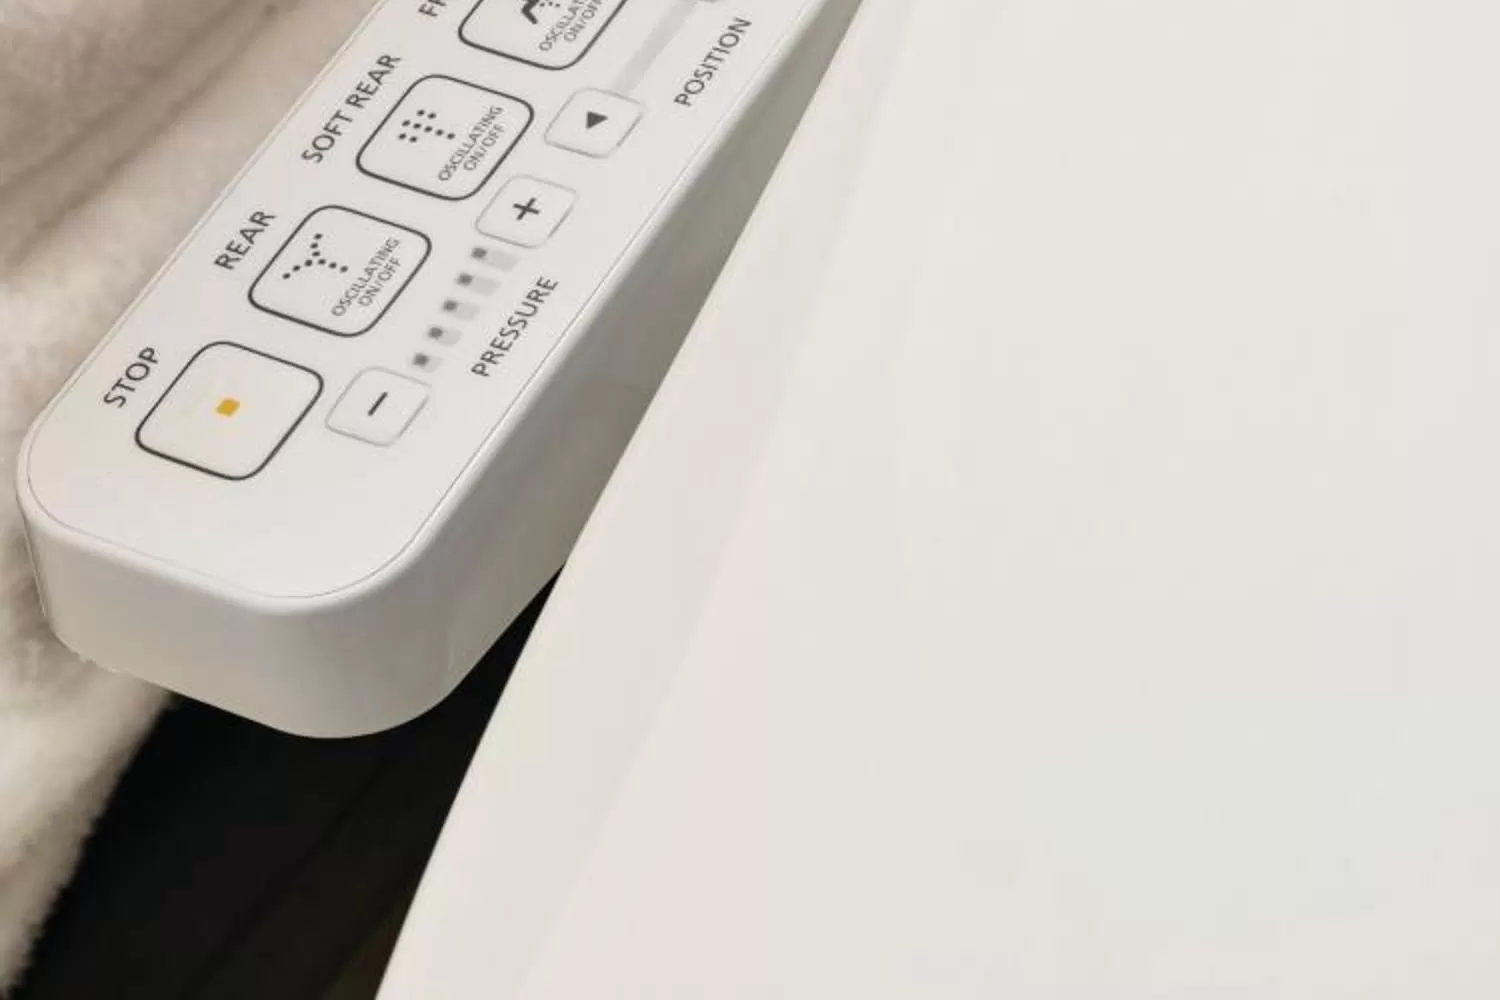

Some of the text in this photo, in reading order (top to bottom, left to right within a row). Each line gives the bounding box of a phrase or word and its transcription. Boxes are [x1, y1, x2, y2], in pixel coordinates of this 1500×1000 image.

[673, 16, 752, 107] POSITION
[301, 52, 401, 165] SOFT REAR
[437, 104, 503, 182] OSCILLATING
[463, 123, 506, 172] ON/OFF
[213, 208, 277, 271] REAR
[330, 236, 401, 318] OSCILLATING
[357, 256, 403, 308] ON/OFF
[470, 276, 559, 379] PRESSURE
[102, 345, 162, 410] STOP
